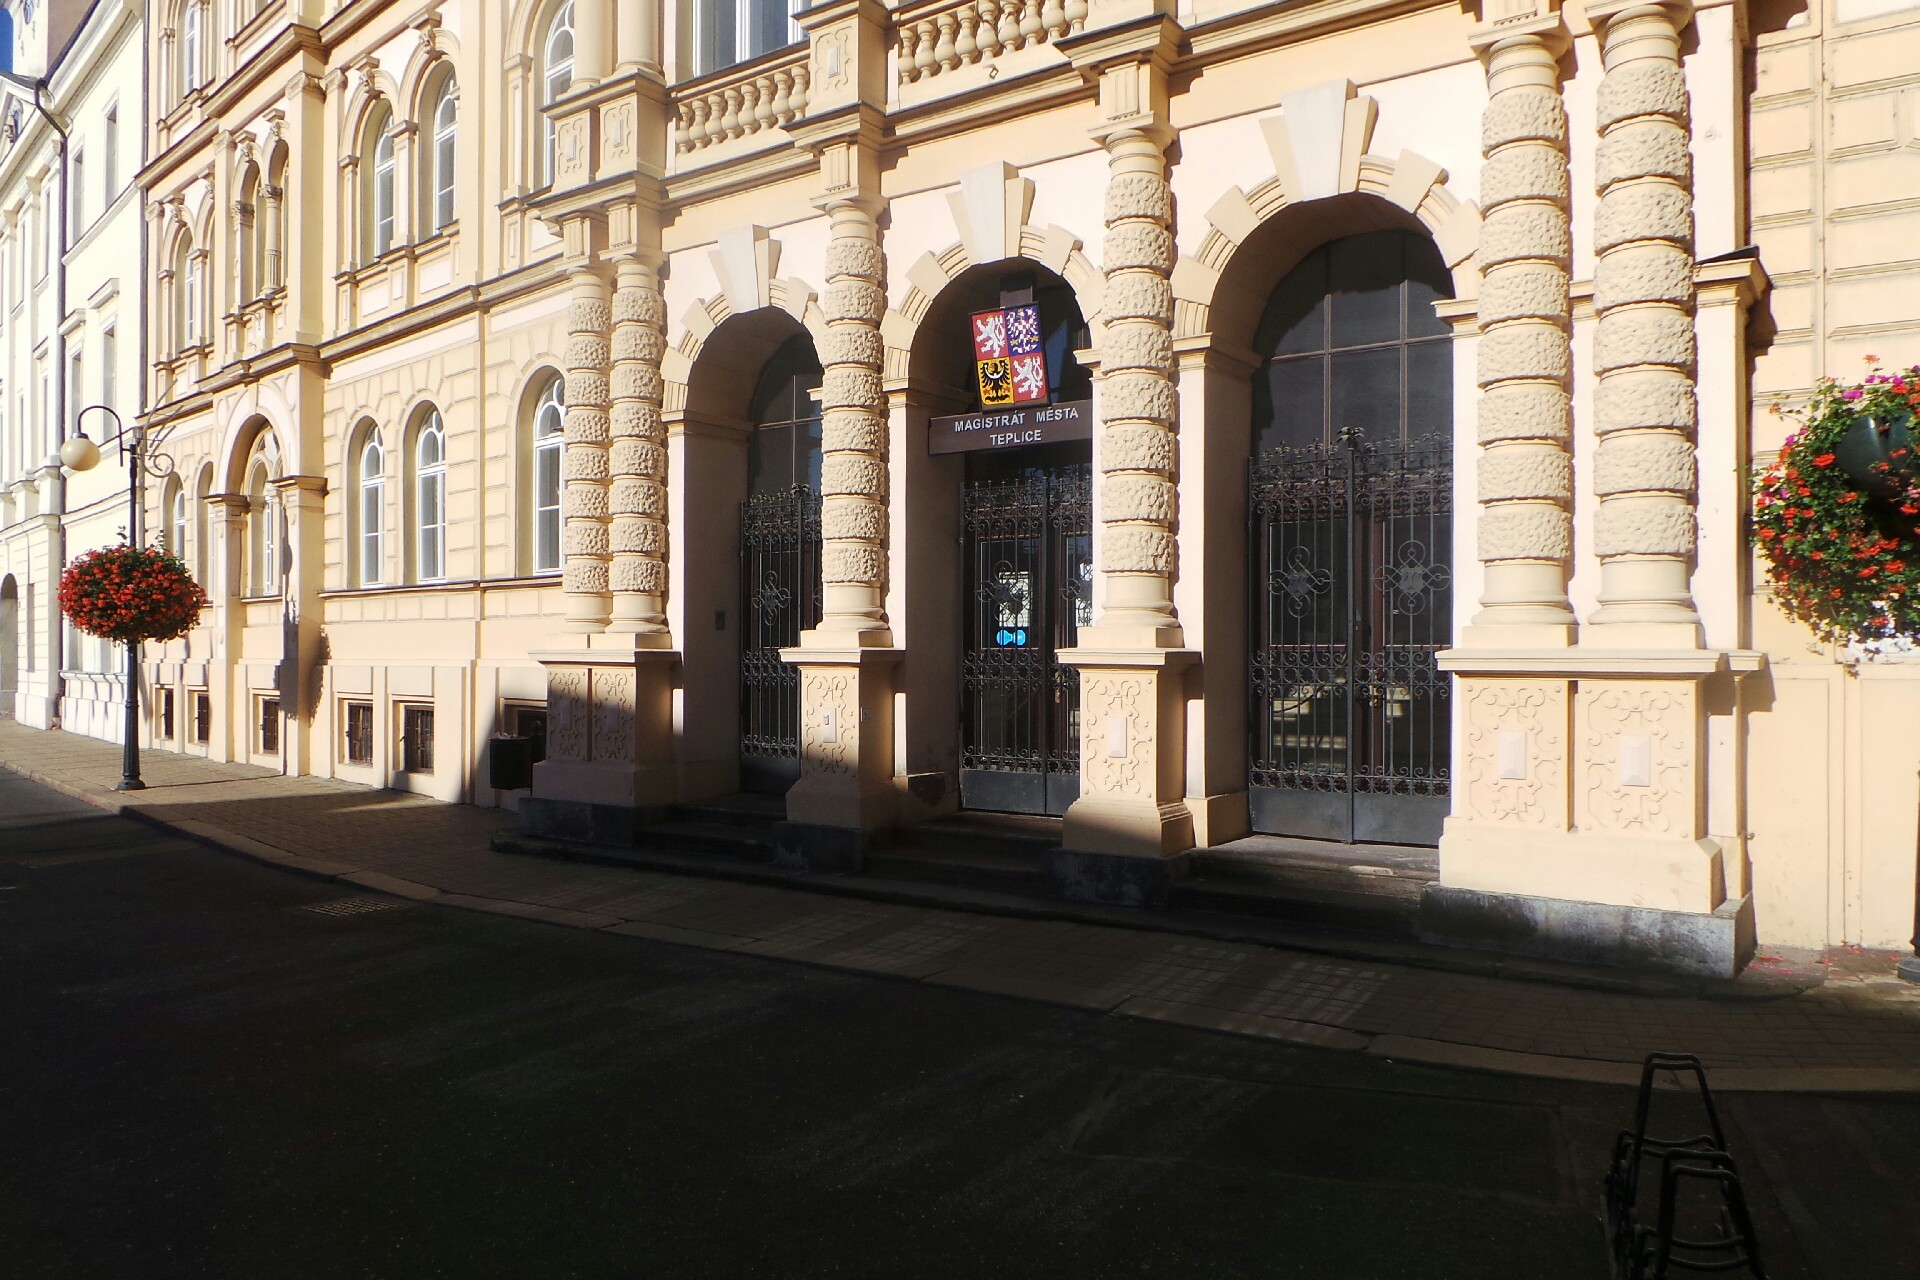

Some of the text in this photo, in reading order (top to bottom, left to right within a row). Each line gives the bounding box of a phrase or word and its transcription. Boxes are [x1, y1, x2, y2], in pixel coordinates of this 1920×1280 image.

[954, 406, 1079, 432] MAGISTRÁT MĚSTA
[990, 429, 1042, 446] TEPLICE
